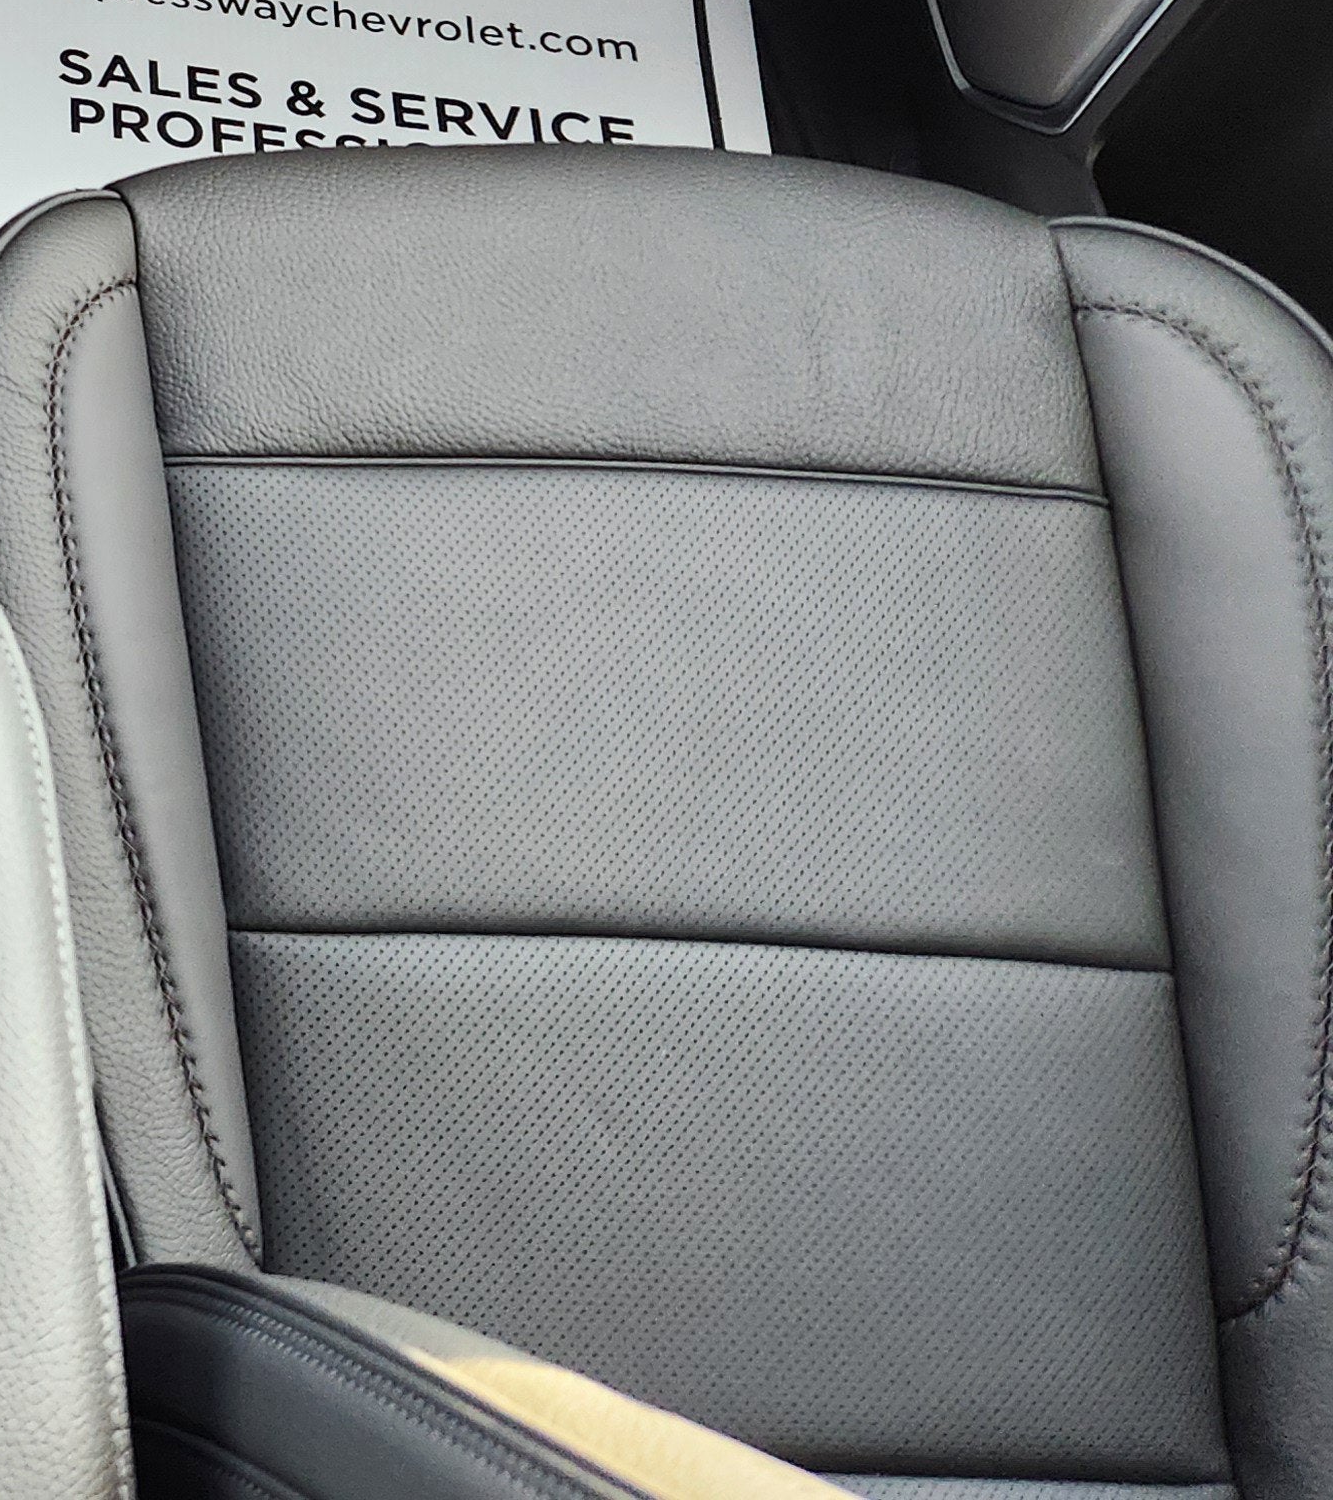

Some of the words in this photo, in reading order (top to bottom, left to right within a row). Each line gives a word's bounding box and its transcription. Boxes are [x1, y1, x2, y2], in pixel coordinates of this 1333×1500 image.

[58, 48, 263, 109] SALES
[285, 80, 327, 119] &
[350, 86, 636, 146] SERVICE
